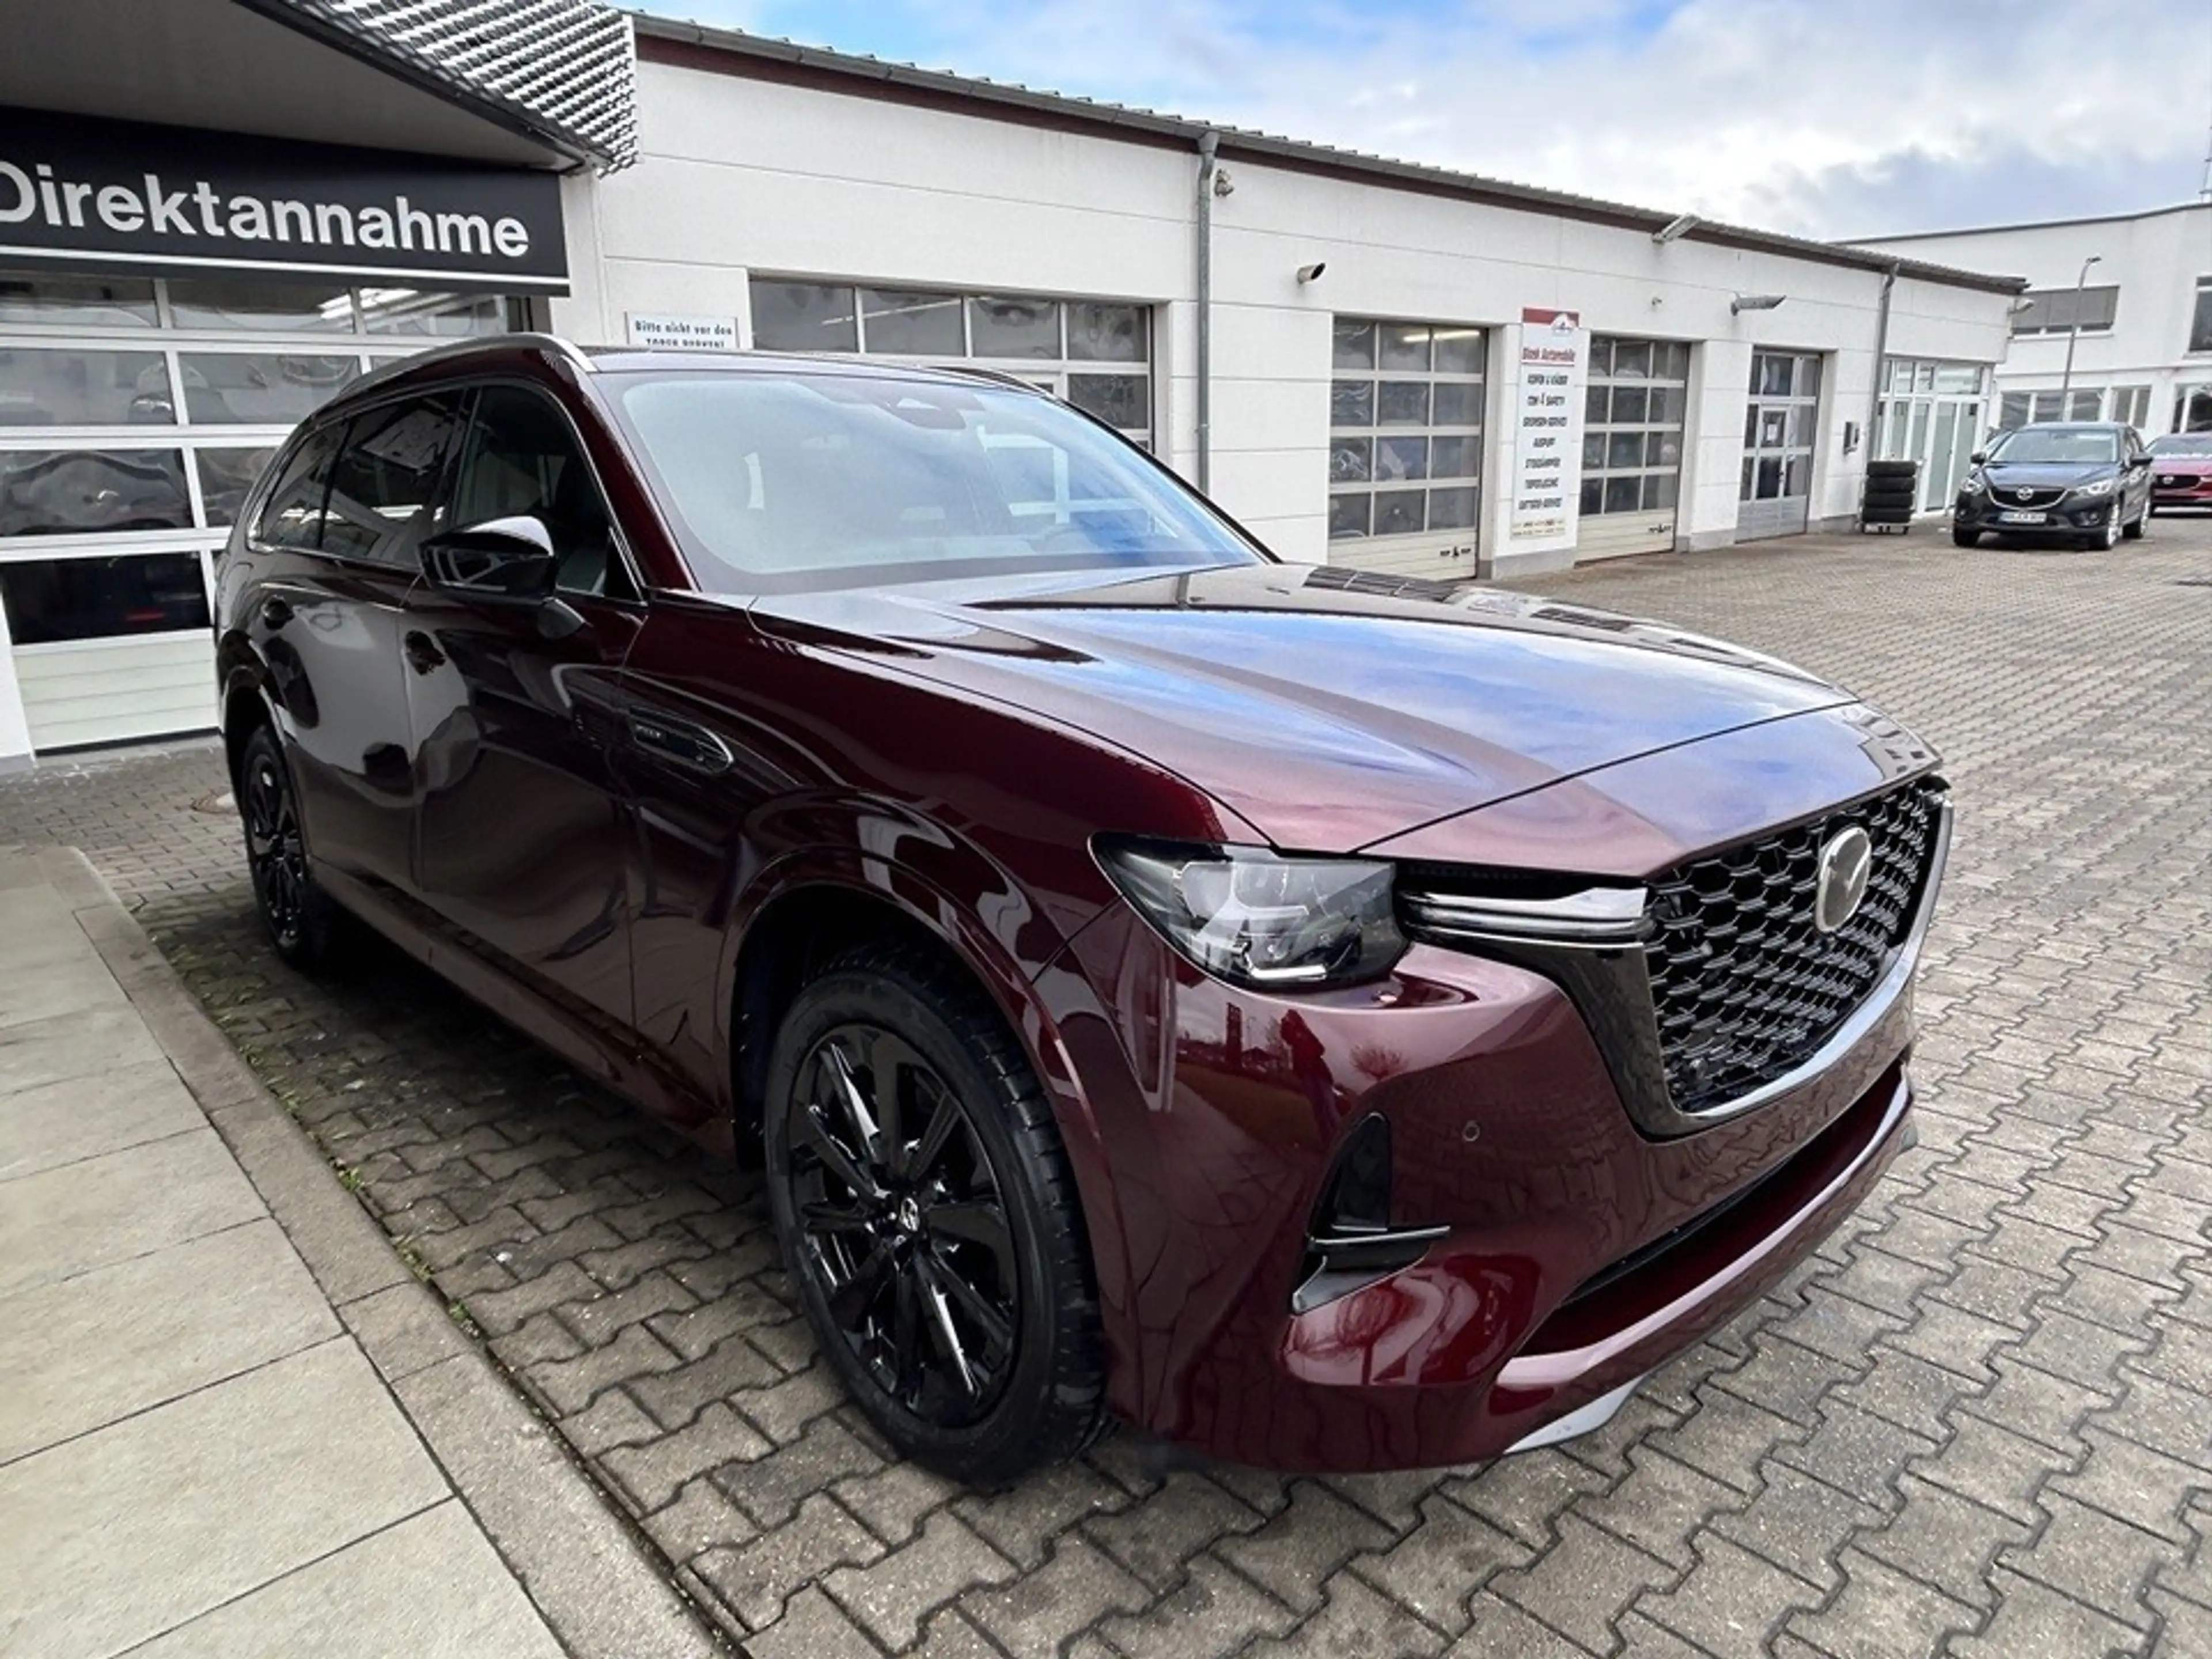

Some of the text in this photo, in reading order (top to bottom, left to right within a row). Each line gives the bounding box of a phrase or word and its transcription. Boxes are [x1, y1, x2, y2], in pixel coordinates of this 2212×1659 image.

[0, 160, 530, 257] Direktannahme
[635, 320, 661, 333] Bitte
[665, 321, 691, 334] nicht
[694, 325, 711, 335] vor
